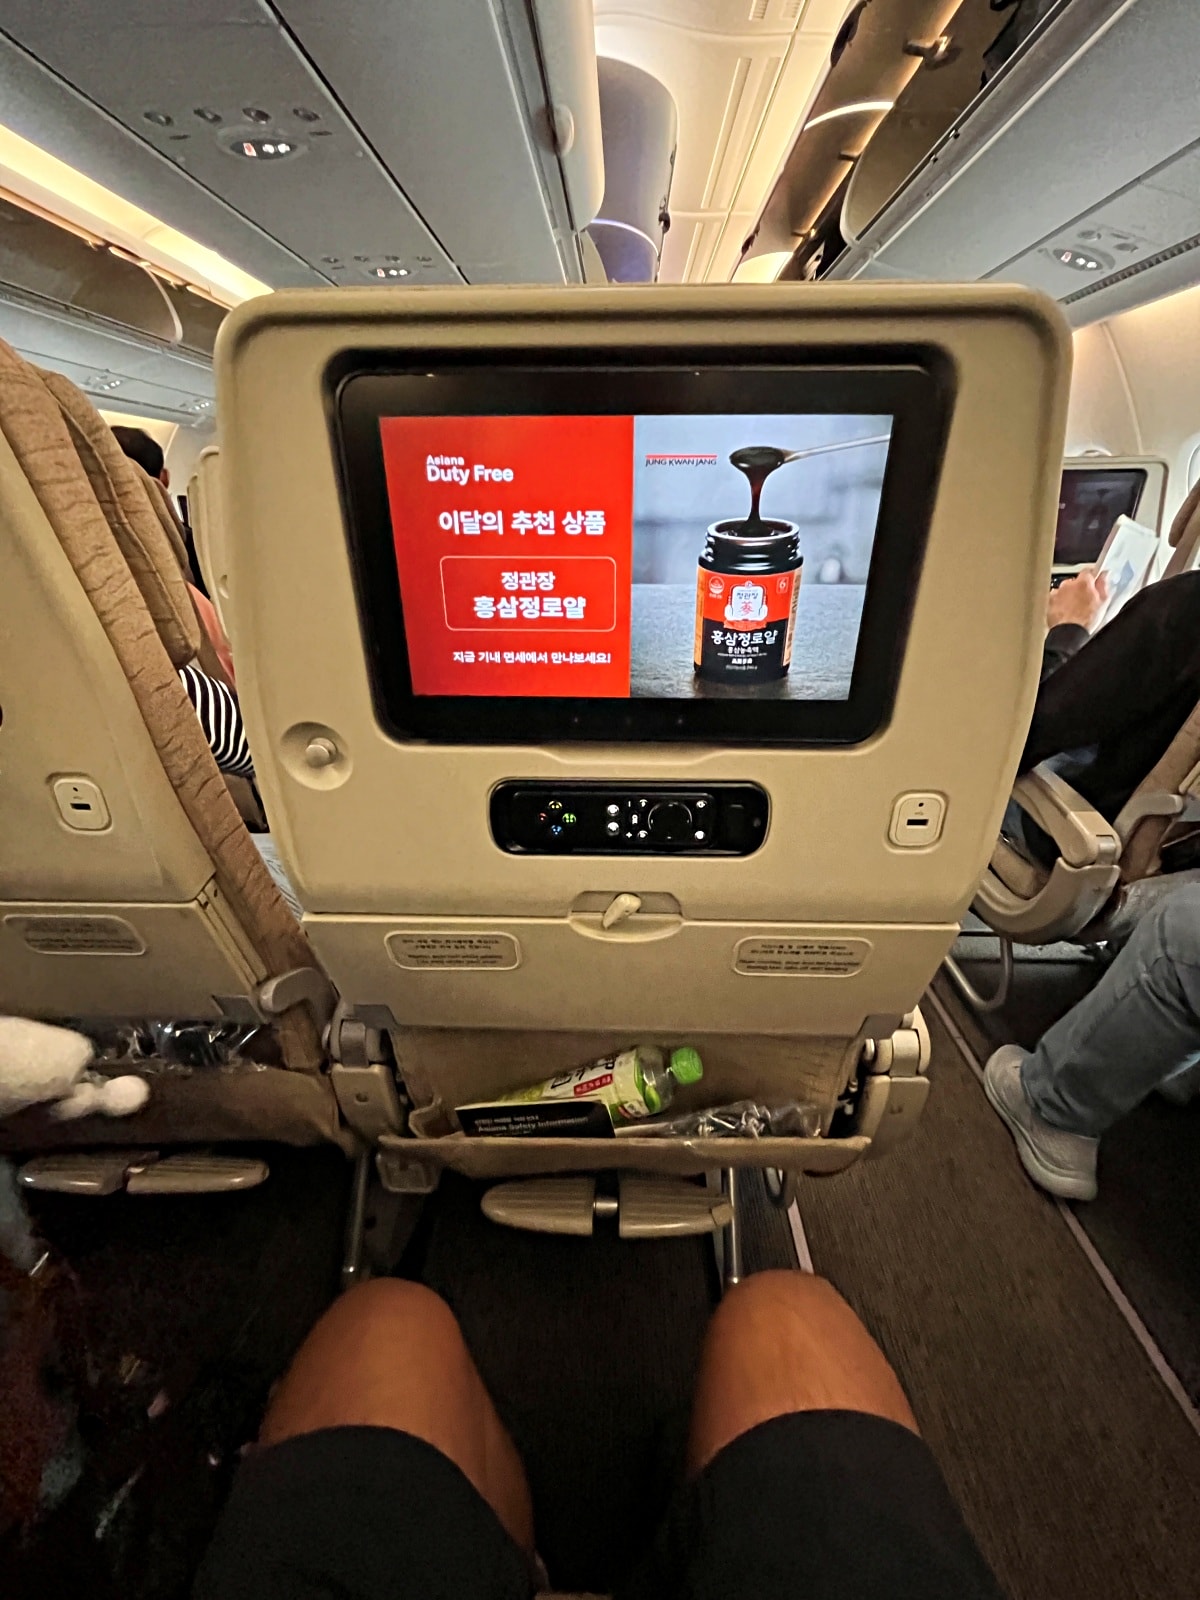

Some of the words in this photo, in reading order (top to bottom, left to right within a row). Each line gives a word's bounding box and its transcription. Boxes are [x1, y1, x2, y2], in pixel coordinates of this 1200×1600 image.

[426, 455, 465, 465] Asiana
[645, 459, 667, 467] JUNG
[695, 459, 717, 467] JANG
[426, 465, 469, 485] Duty
[473, 464, 514, 482] Free
[438, 510, 504, 535] 이달의
[511, 510, 555, 535] 추천
[561, 510, 606, 535] 상품
[501, 571, 556, 591] 정관장
[473, 596, 586, 619] 홍삼정로얄
[711, 630, 778, 647] 홍삼정로얄
[453, 651, 475, 663] 지금
[478, 651, 501, 663] 기내
[503, 651, 548, 663] 면세에서
[551, 651, 611, 664] 만나보세요!
